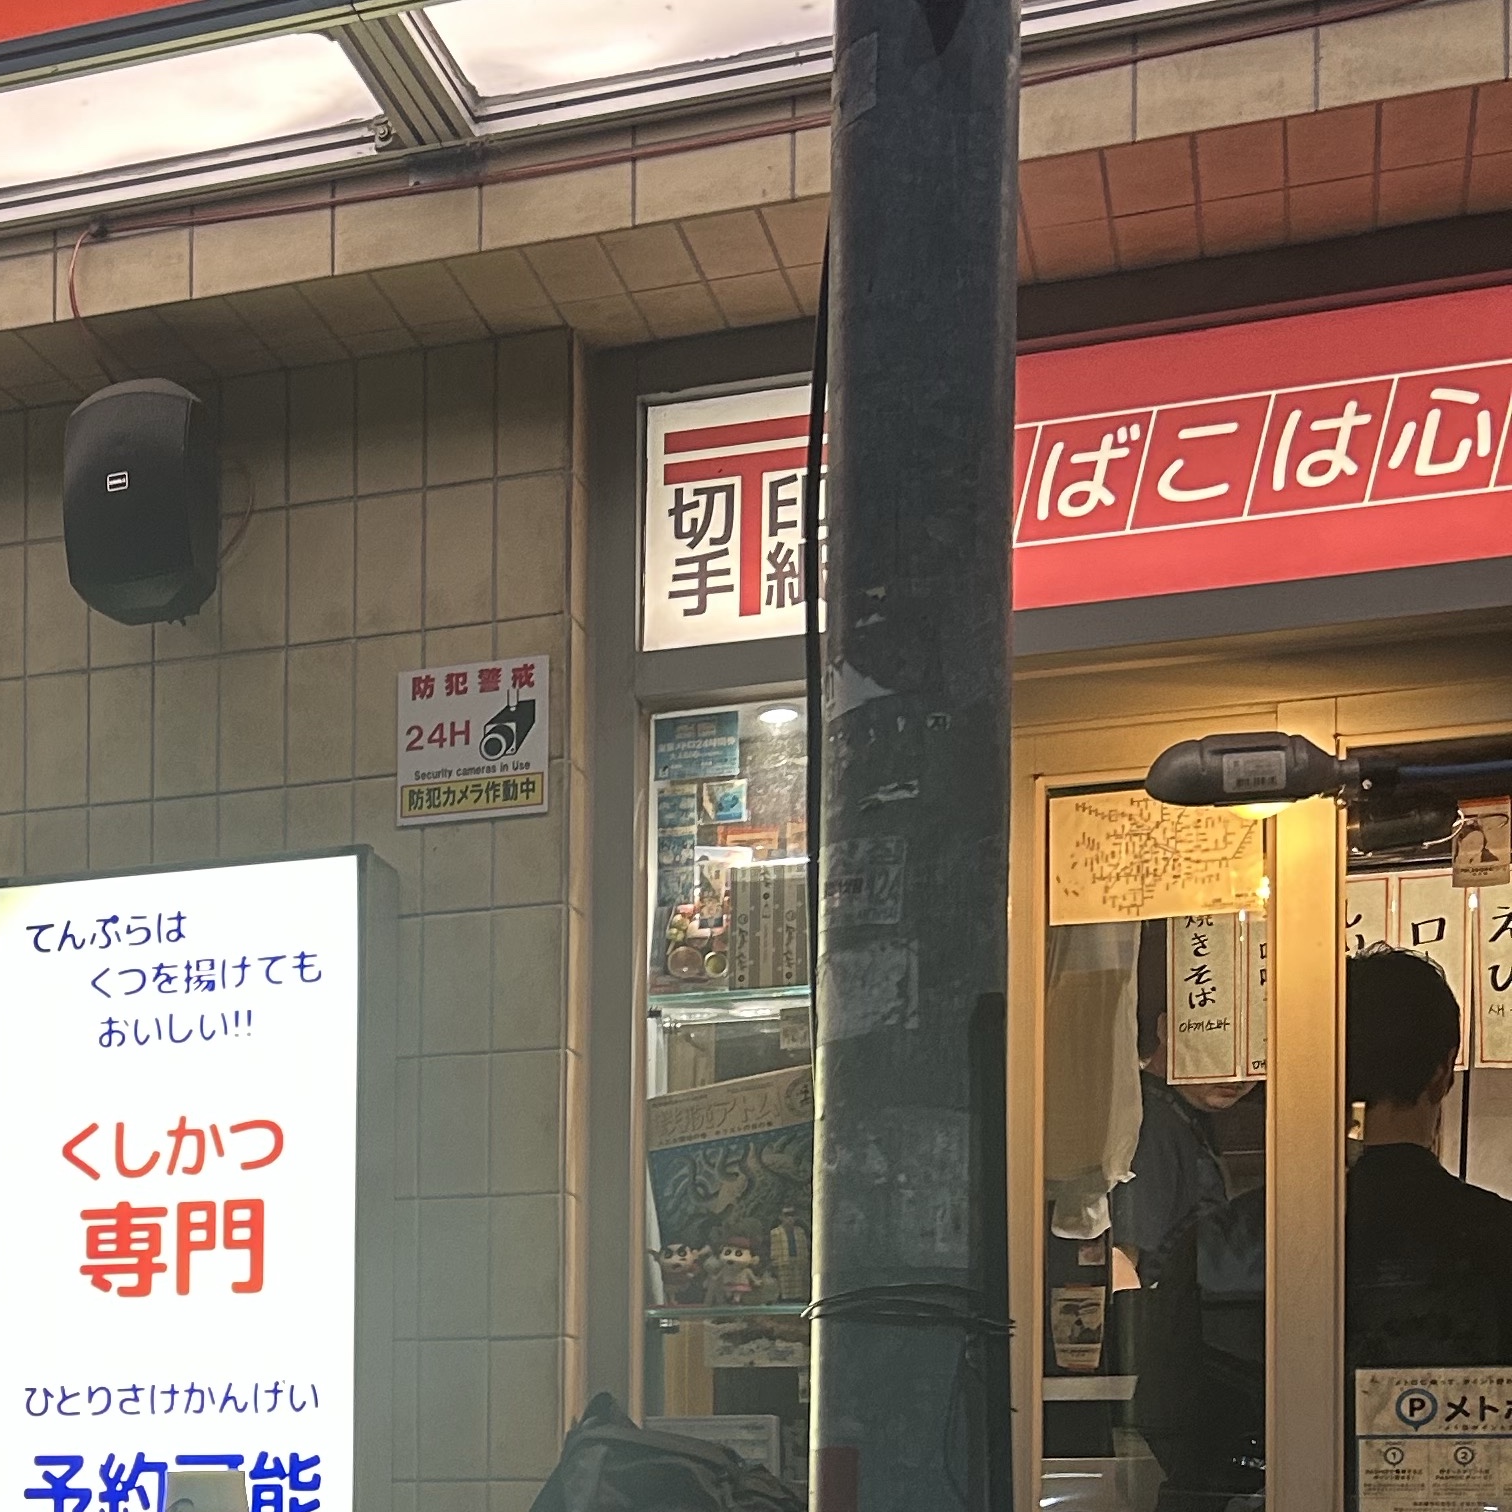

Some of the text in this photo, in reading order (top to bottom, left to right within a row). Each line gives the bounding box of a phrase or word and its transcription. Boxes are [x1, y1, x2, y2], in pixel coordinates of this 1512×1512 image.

[1037, 387, 1492, 521] ばこは心
[668, 483, 735, 617] 切手
[411, 663, 535, 701] 防犯警戒
[405, 719, 471, 752] 24H
[414, 768, 452, 781] Security
[456, 762, 497, 777] cameras
[512, 759, 531, 771] Use
[408, 776, 536, 812] 防犯カメラ作動中
[26, 910, 187, 953] てんぷらは
[62, 1115, 284, 1181] くしかつ
[79, 1199, 265, 1297] 専門
